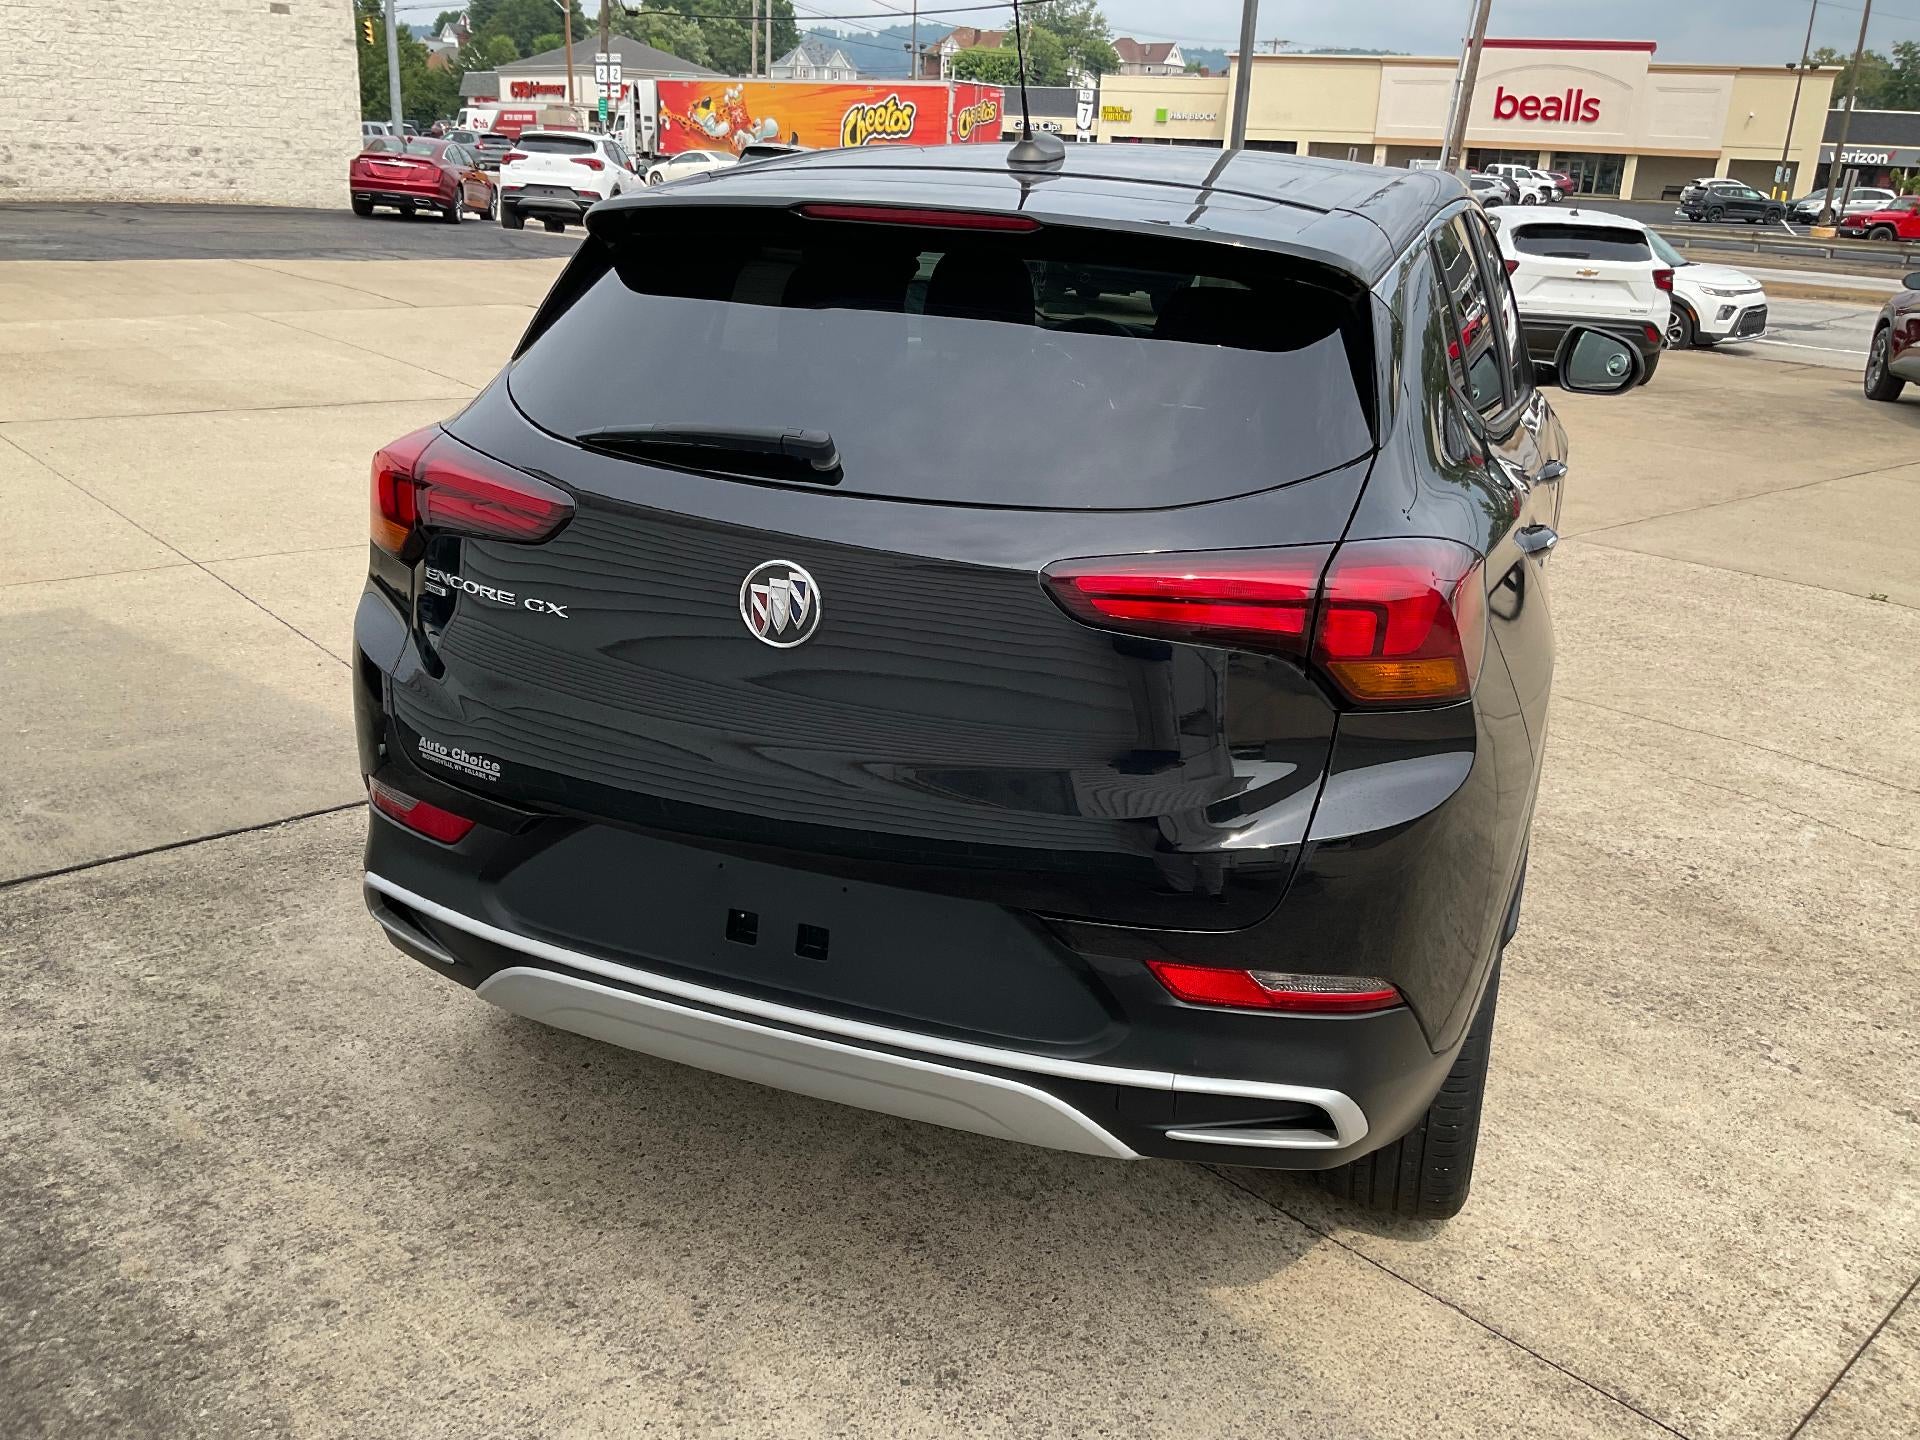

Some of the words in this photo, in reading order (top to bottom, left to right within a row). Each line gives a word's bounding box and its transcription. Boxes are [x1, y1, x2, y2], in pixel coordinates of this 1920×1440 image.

[841, 94, 916, 148] Cheetos
[958, 99, 998, 140] Cheetos
[1082, 108, 1089, 122] 7
[1189, 112, 1217, 121] BLOCK
[1493, 86, 1601, 123] bealls
[1014, 120, 1039, 132] Grat
[1041, 121, 1062, 133] Clips
[425, 566, 516, 606] ENCORE
[524, 598, 569, 619] GX
[419, 736, 448, 755] Auto
[451, 747, 501, 772] Choice
